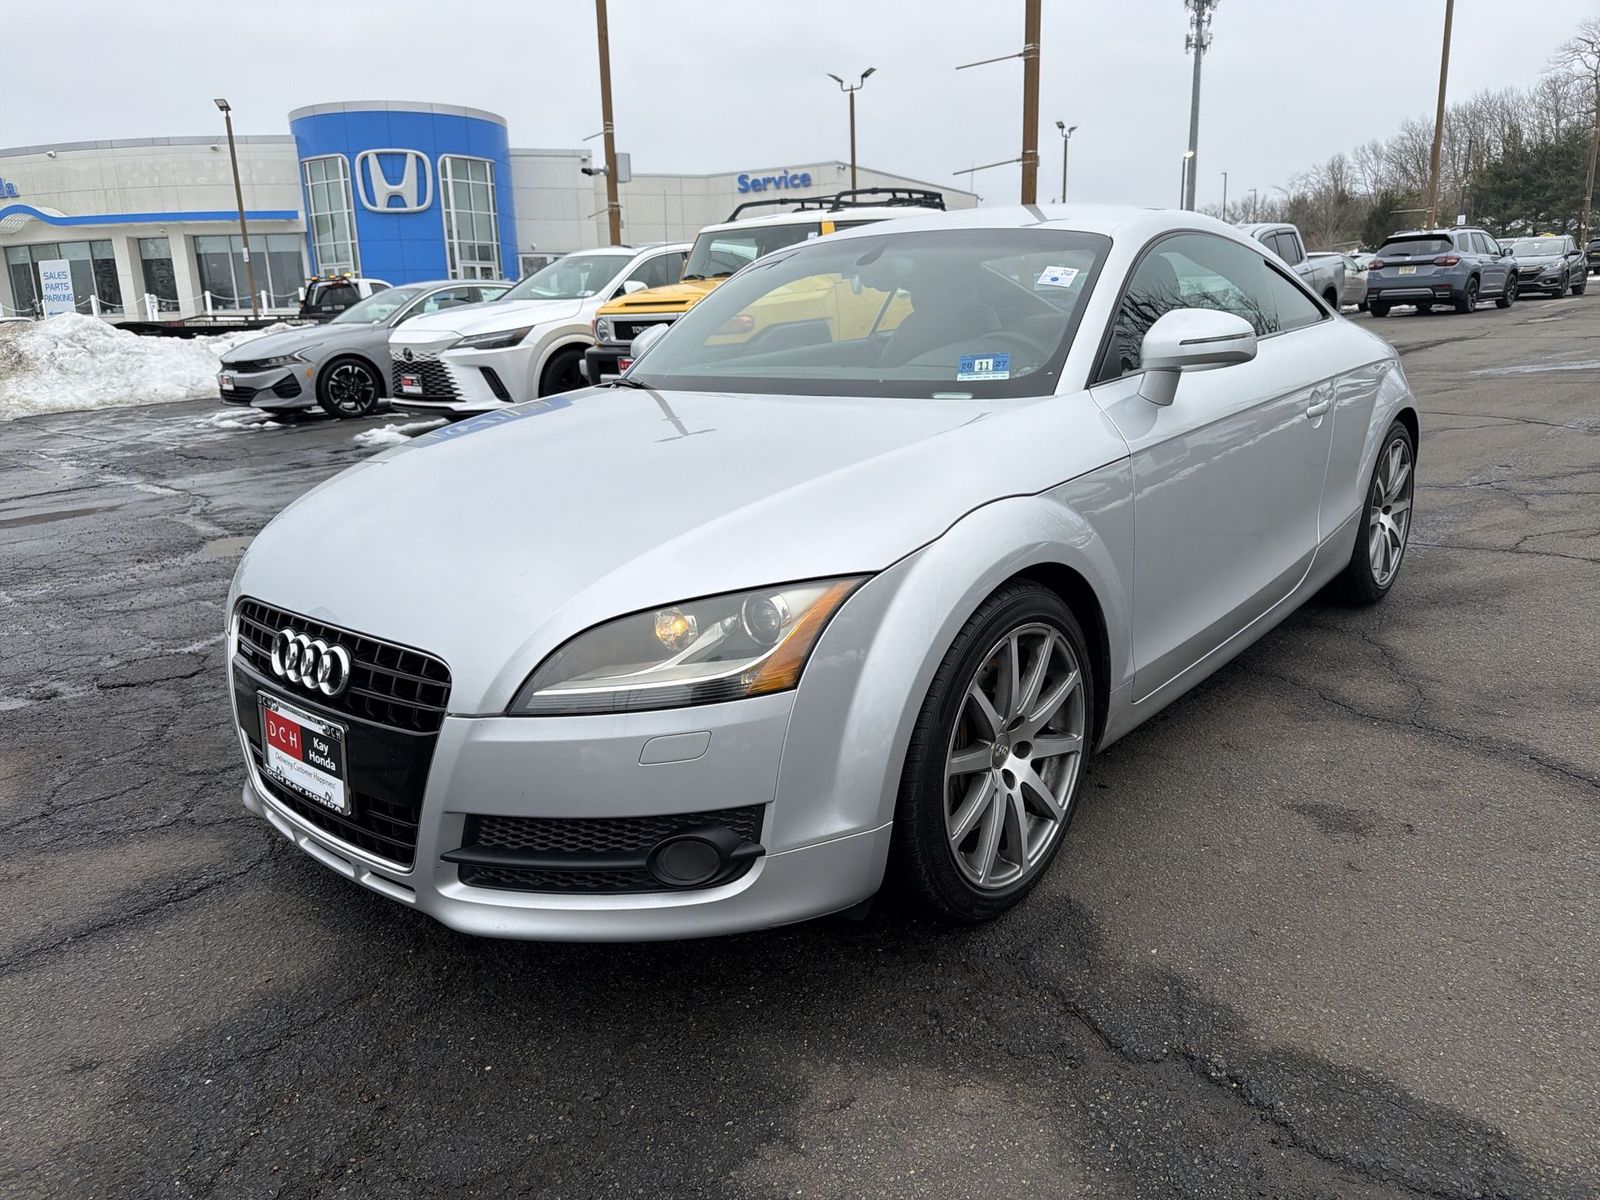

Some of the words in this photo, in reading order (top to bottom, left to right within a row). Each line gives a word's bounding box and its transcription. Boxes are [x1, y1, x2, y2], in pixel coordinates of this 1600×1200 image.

[737, 169, 812, 193] Service
[43, 271, 68, 280] SALES
[45, 282, 69, 291] PARTS
[44, 293, 74, 302] PARKING
[961, 362, 973, 370] 20
[978, 360, 990, 371] 11
[995, 360, 1008, 368] 27
[269, 720, 298, 749] DCH
[313, 737, 329, 756] Kay
[308, 749, 336, 771] Honda
[266, 768, 284, 782] DCH
[285, 780, 303, 793] KAY
[304, 790, 342, 813] HONDA
